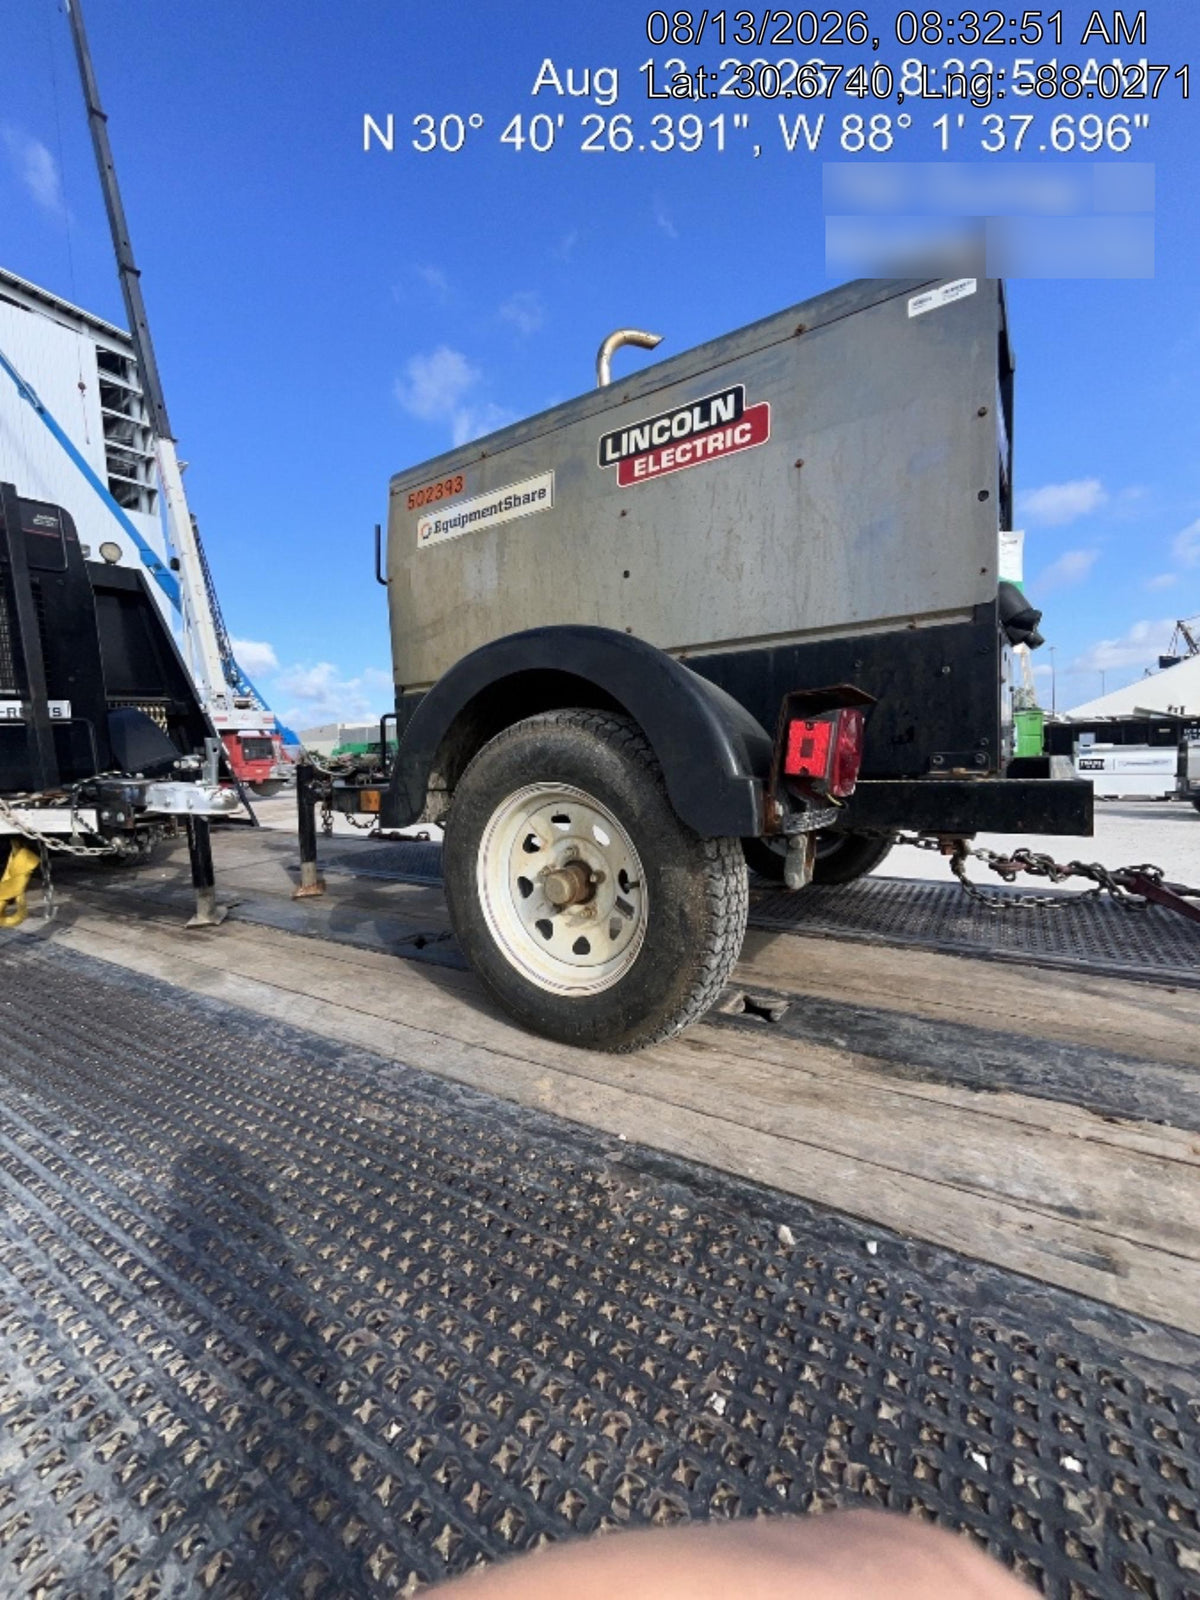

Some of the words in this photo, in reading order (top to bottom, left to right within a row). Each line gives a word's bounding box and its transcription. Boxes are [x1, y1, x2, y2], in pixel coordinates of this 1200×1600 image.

[605, 393, 736, 462] LINCOLN
[633, 422, 752, 478] ELECTRIC
[407, 475, 464, 511] 502393
[433, 487, 547, 534] EquipmentShare
